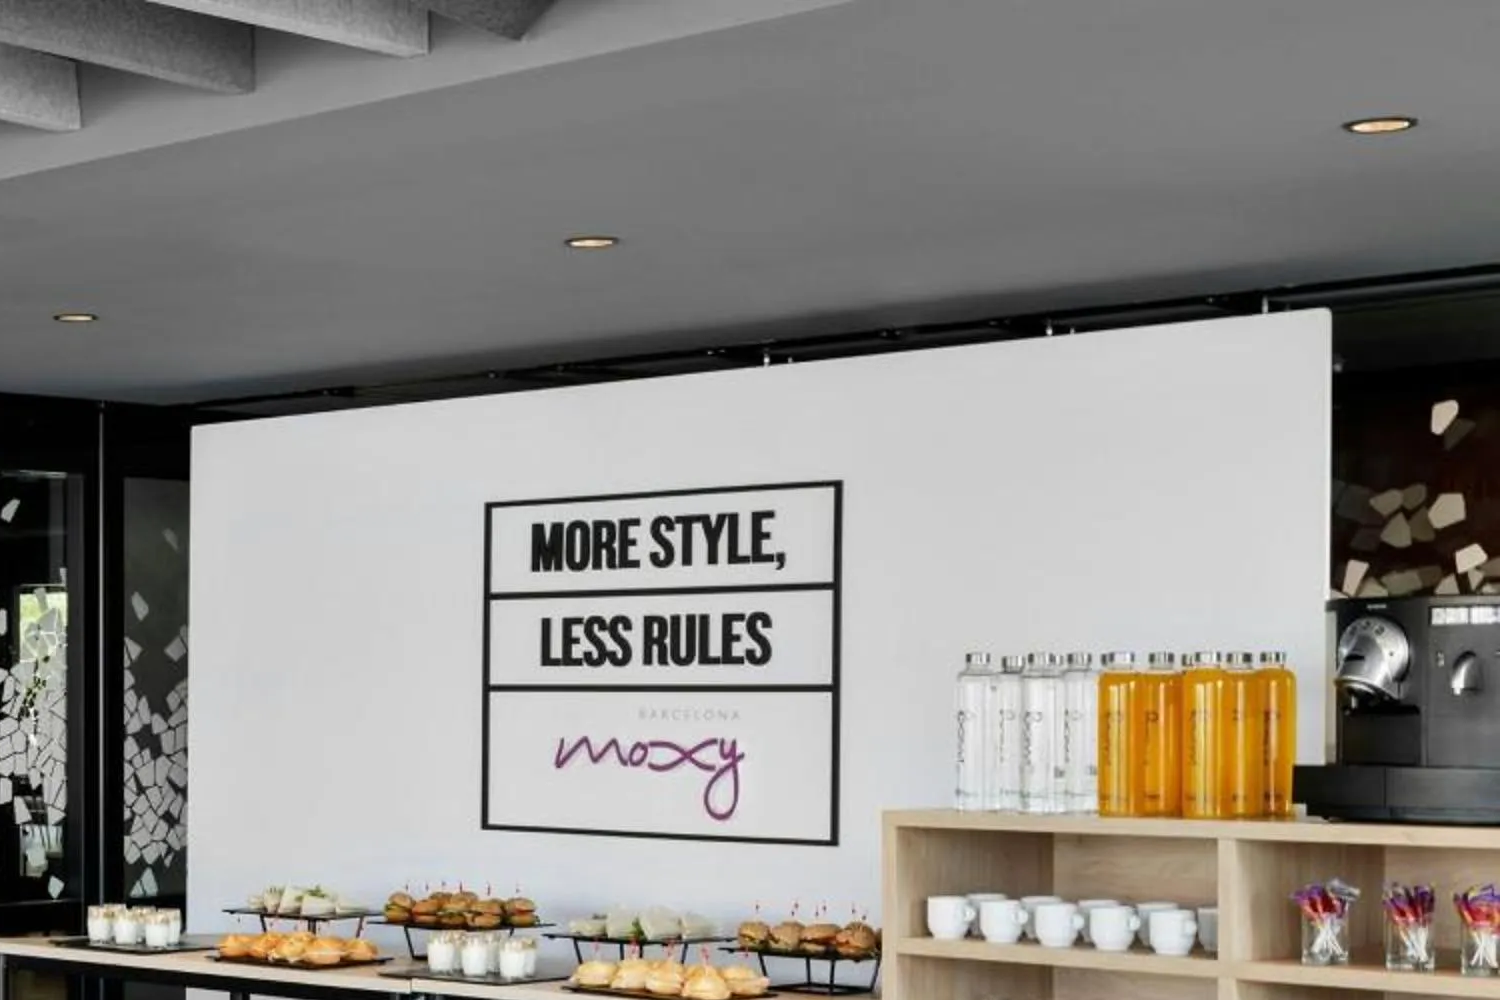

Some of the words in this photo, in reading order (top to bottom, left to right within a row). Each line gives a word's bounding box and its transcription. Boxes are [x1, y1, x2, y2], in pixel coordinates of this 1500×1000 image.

[530, 517, 641, 573] MORE
[649, 509, 787, 571] STYLE,
[540, 614, 633, 668] LESS
[642, 611, 773, 667] RULES
[638, 708, 741, 721] BARCELONA
[554, 735, 745, 821] moxy
